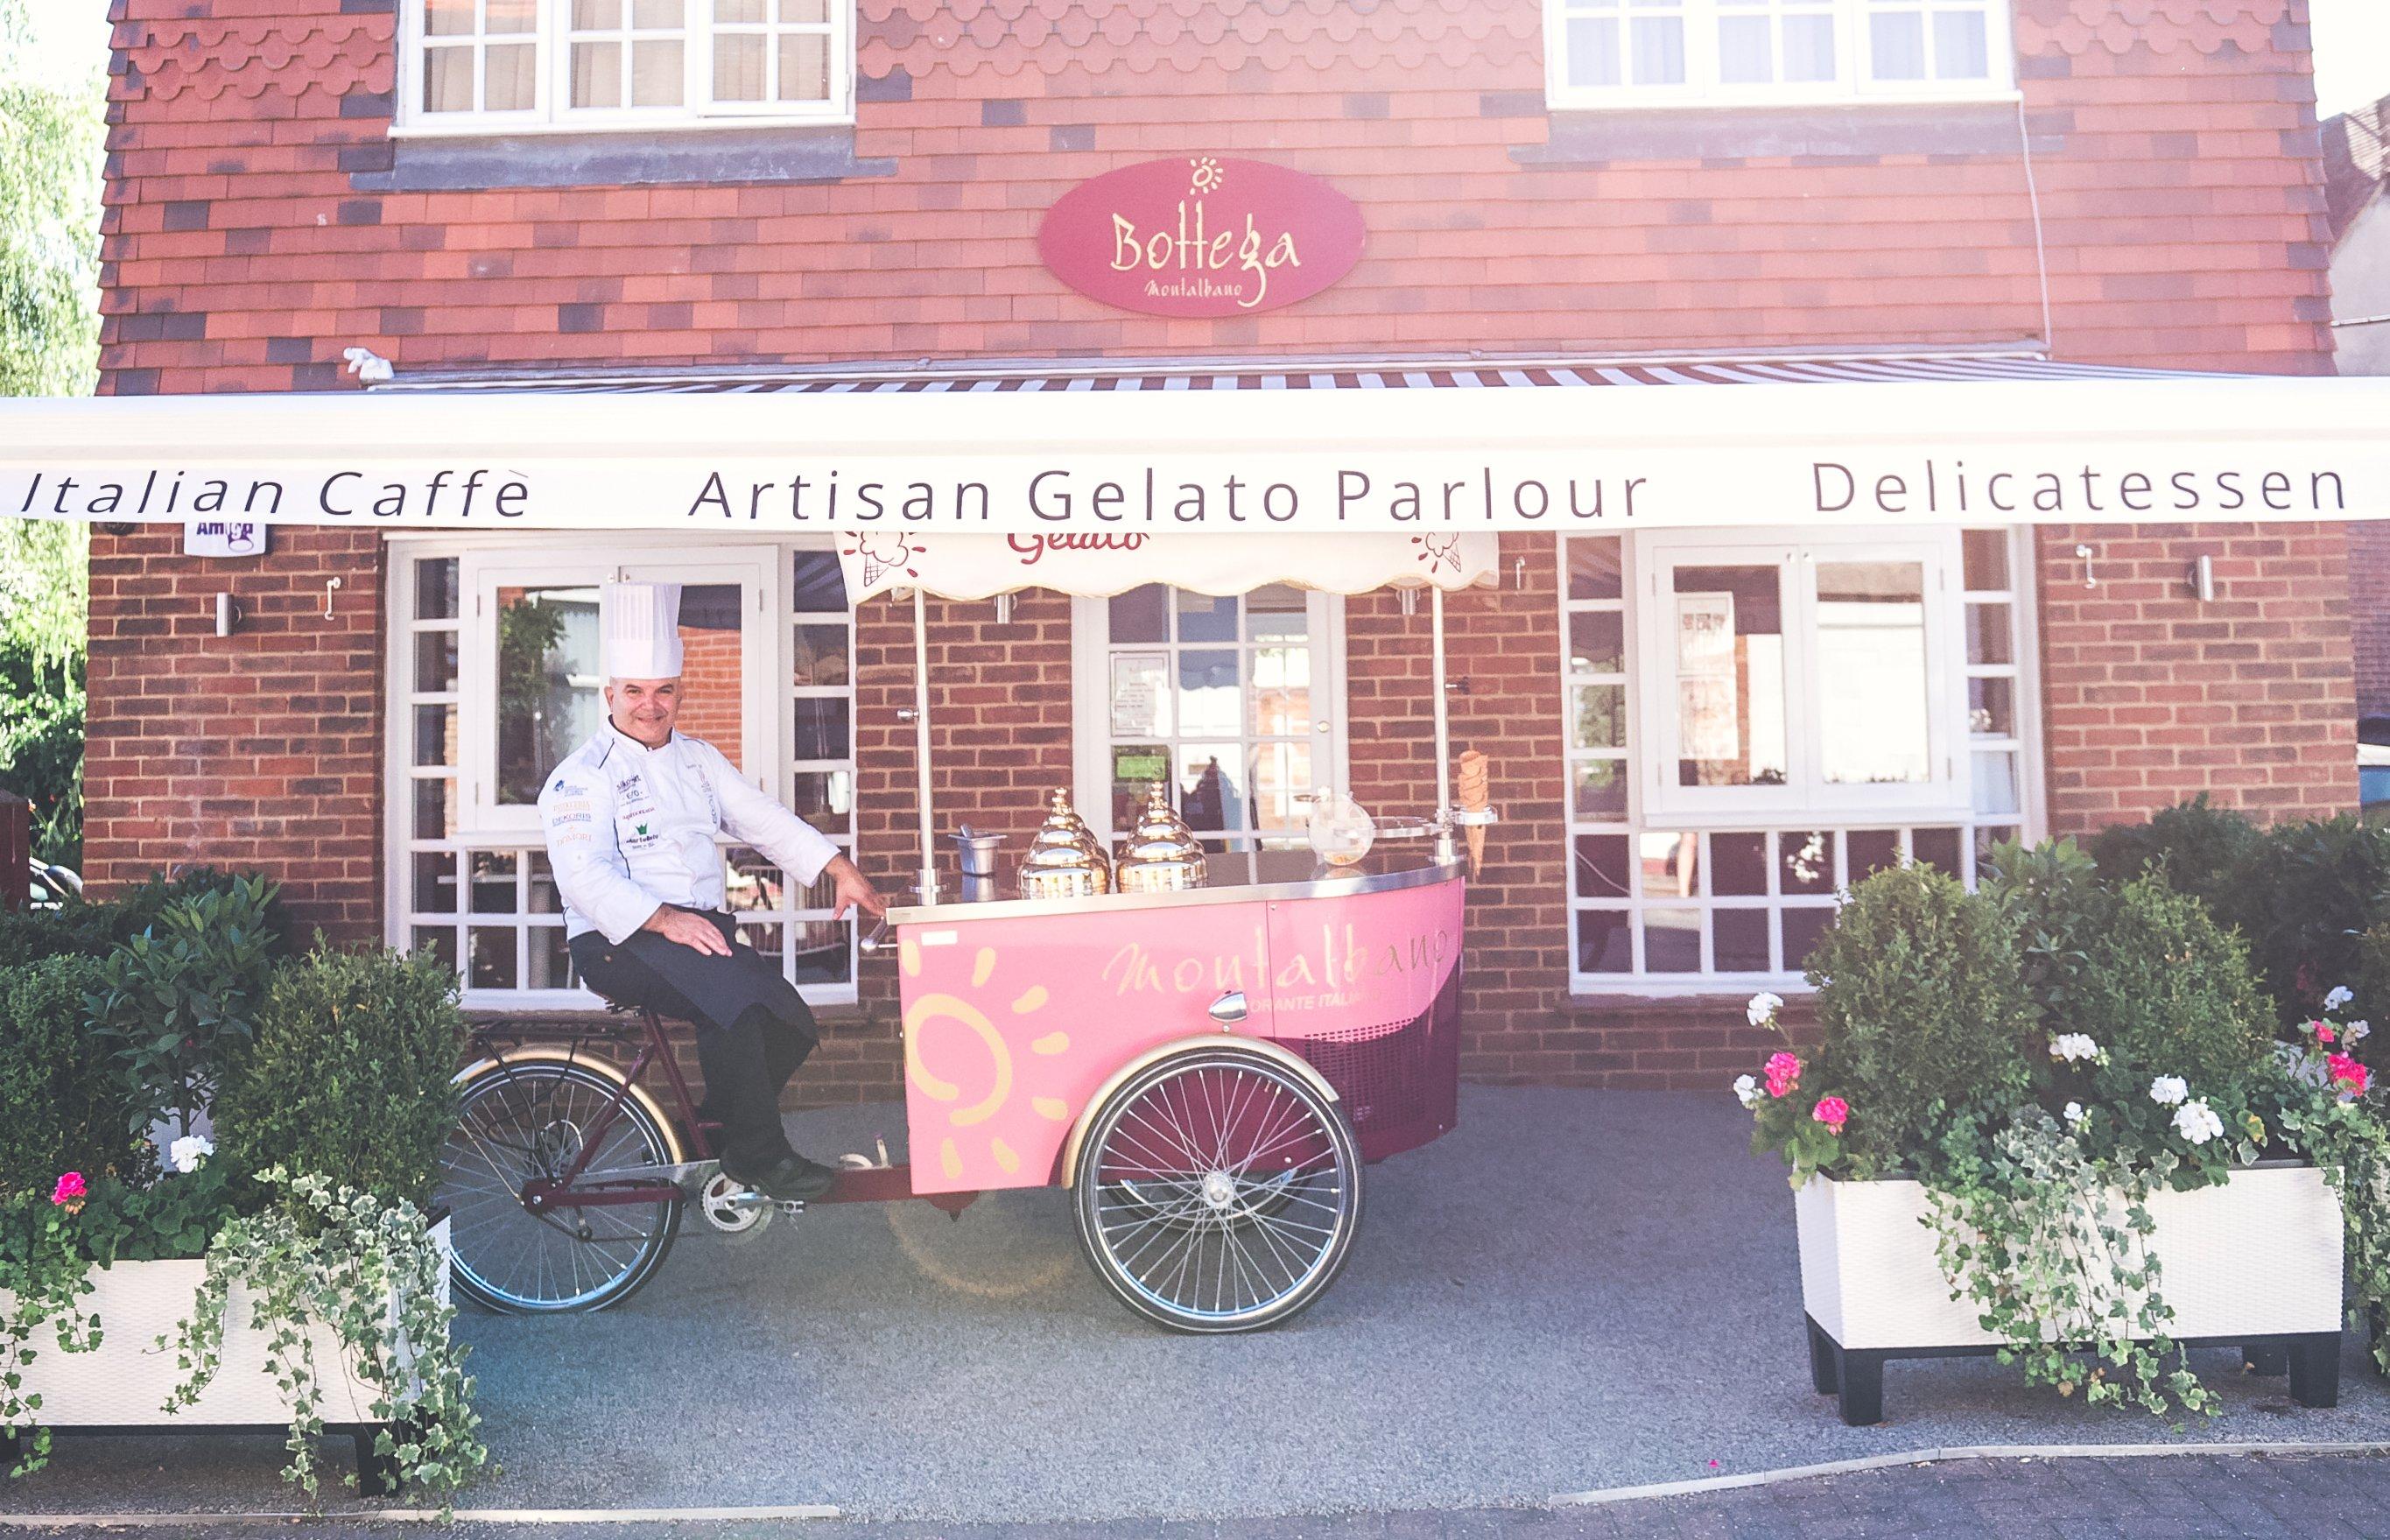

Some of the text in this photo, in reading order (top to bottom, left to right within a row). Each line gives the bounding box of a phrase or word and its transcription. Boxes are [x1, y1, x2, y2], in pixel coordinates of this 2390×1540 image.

[1110, 199, 1302, 307] Bottega
[1144, 277, 1242, 298] Montalbano
[21, 460, 2346, 523] Italian Caffè Artisan Gelato Parlour Delicatessen
[1247, 995, 1314, 1013] ORANTE
